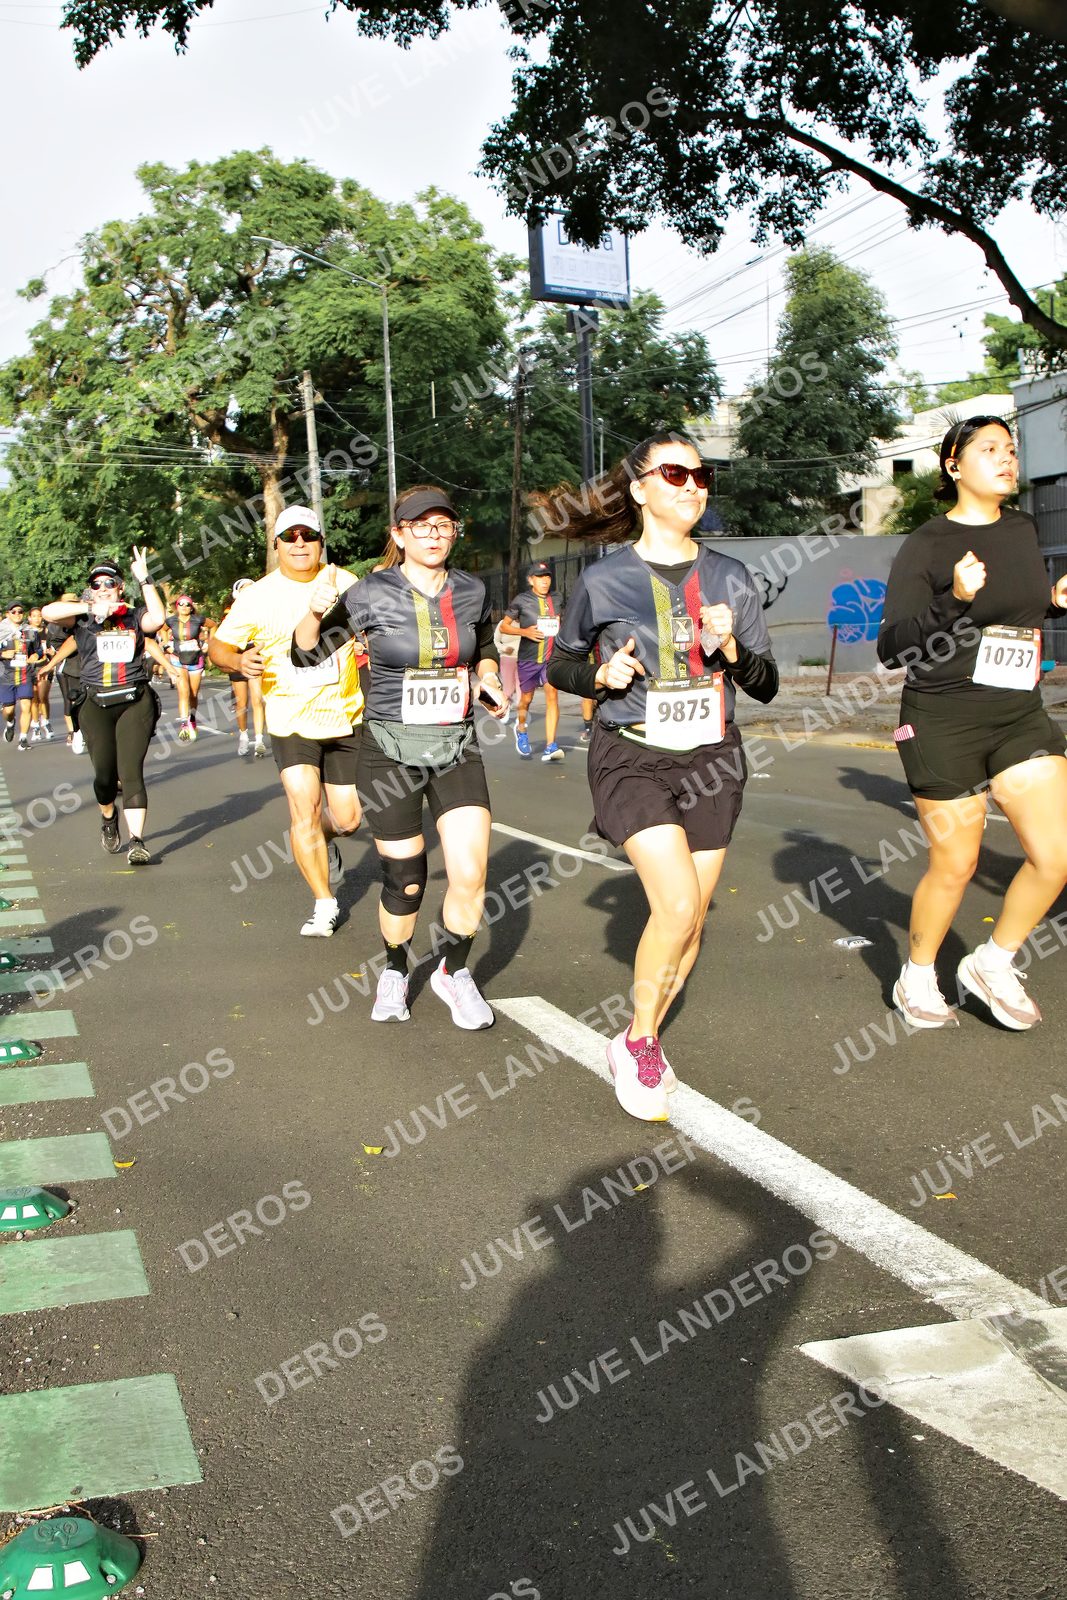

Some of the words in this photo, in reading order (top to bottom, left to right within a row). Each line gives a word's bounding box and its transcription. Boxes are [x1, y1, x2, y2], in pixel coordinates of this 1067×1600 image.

[984, 645, 1034, 668] 10737
[407, 686, 461, 706] 10176
[657, 698, 711, 723] 9875
